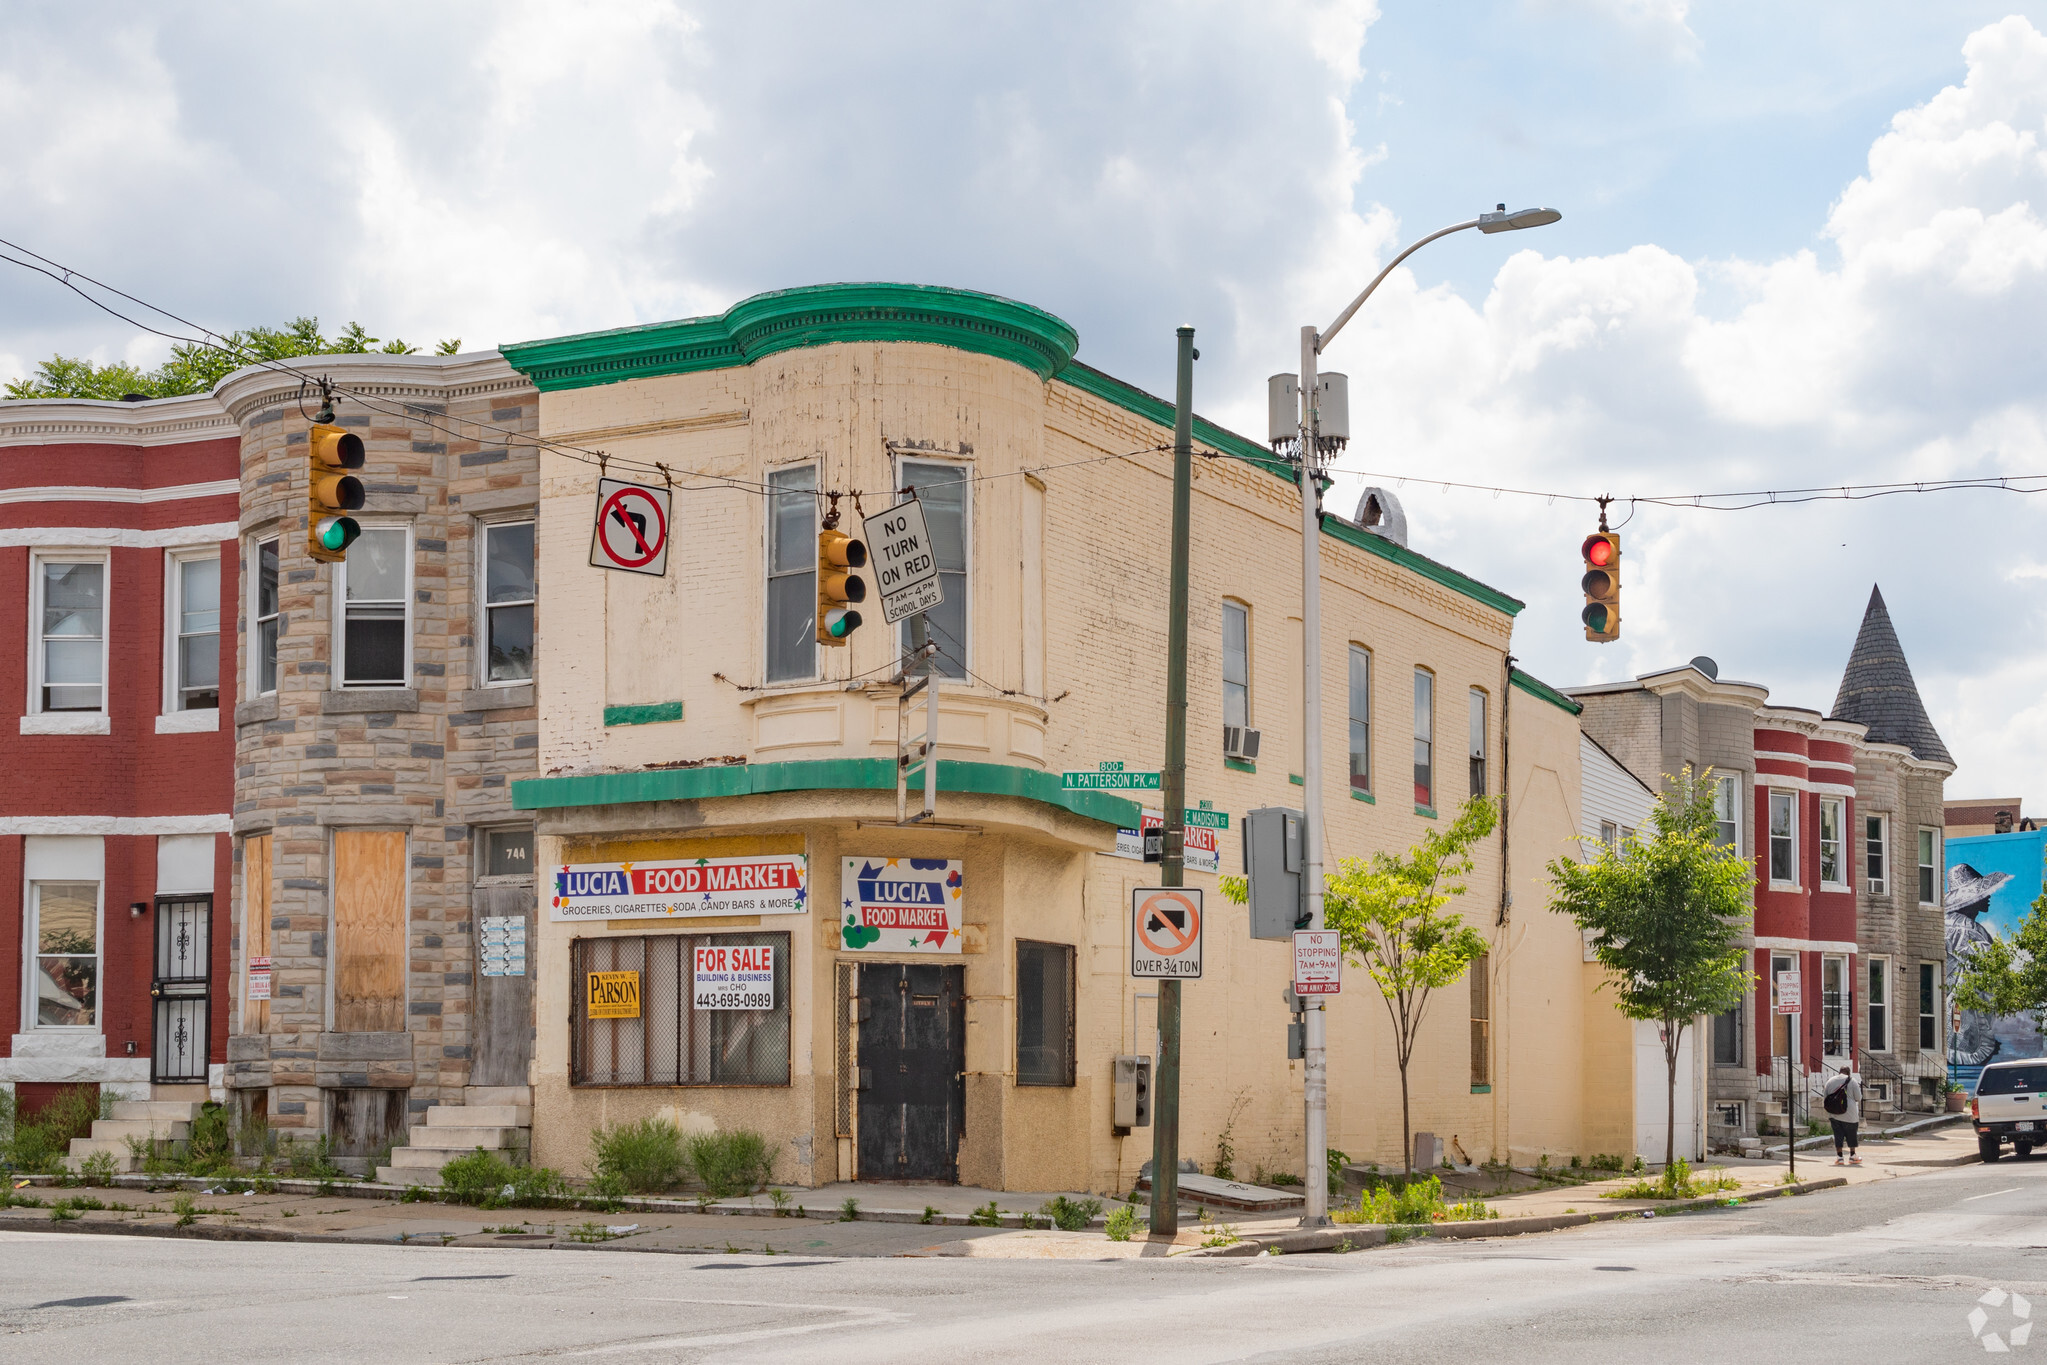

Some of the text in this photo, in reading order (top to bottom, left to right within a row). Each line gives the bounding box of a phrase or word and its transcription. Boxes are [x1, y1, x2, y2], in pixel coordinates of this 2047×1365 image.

[884, 516, 906, 537] NO
[882, 535, 919, 561] TURN
[882, 554, 930, 586] ON RED
[890, 592, 938, 619] SCHOOL DAYS
[1100, 762, 1118, 771] 800
[1066, 774, 1075, 787] N.
[1078, 774, 1130, 787] PATTERSON
[1134, 774, 1147, 787] PK.
[1193, 812, 1219, 826] MADISON
[1184, 827, 1213, 849] ARKET
[506, 847, 525, 860] 744
[1202, 858, 1214, 868] MORE
[567, 864, 792, 896] LUCIA FOOD MARKET
[874, 882, 931, 902] LUCIA
[562, 905, 613, 915] GROCERIES,
[615, 903, 666, 913] CIGARETTES
[673, 902, 696, 912] SODA
[732, 899, 754, 909] BARS
[760, 898, 766, 908] &
[768, 898, 793, 908] MORE
[866, 908, 944, 926] FOOD MARKET
[1310, 935, 1322, 944] NO
[696, 948, 770, 971] FOR SALE
[1298, 948, 1336, 957] STOPPING
[1136, 959, 1162, 972] OVER
[1179, 960, 1198, 972] TON
[1299, 960, 1336, 969] 7AM-9AM
[590, 975, 636, 1004] PARSON
[1309, 984, 1323, 992] AWAY
[1325, 983, 1338, 991] ZONE
[697, 993, 770, 1007] 443-695-0989
